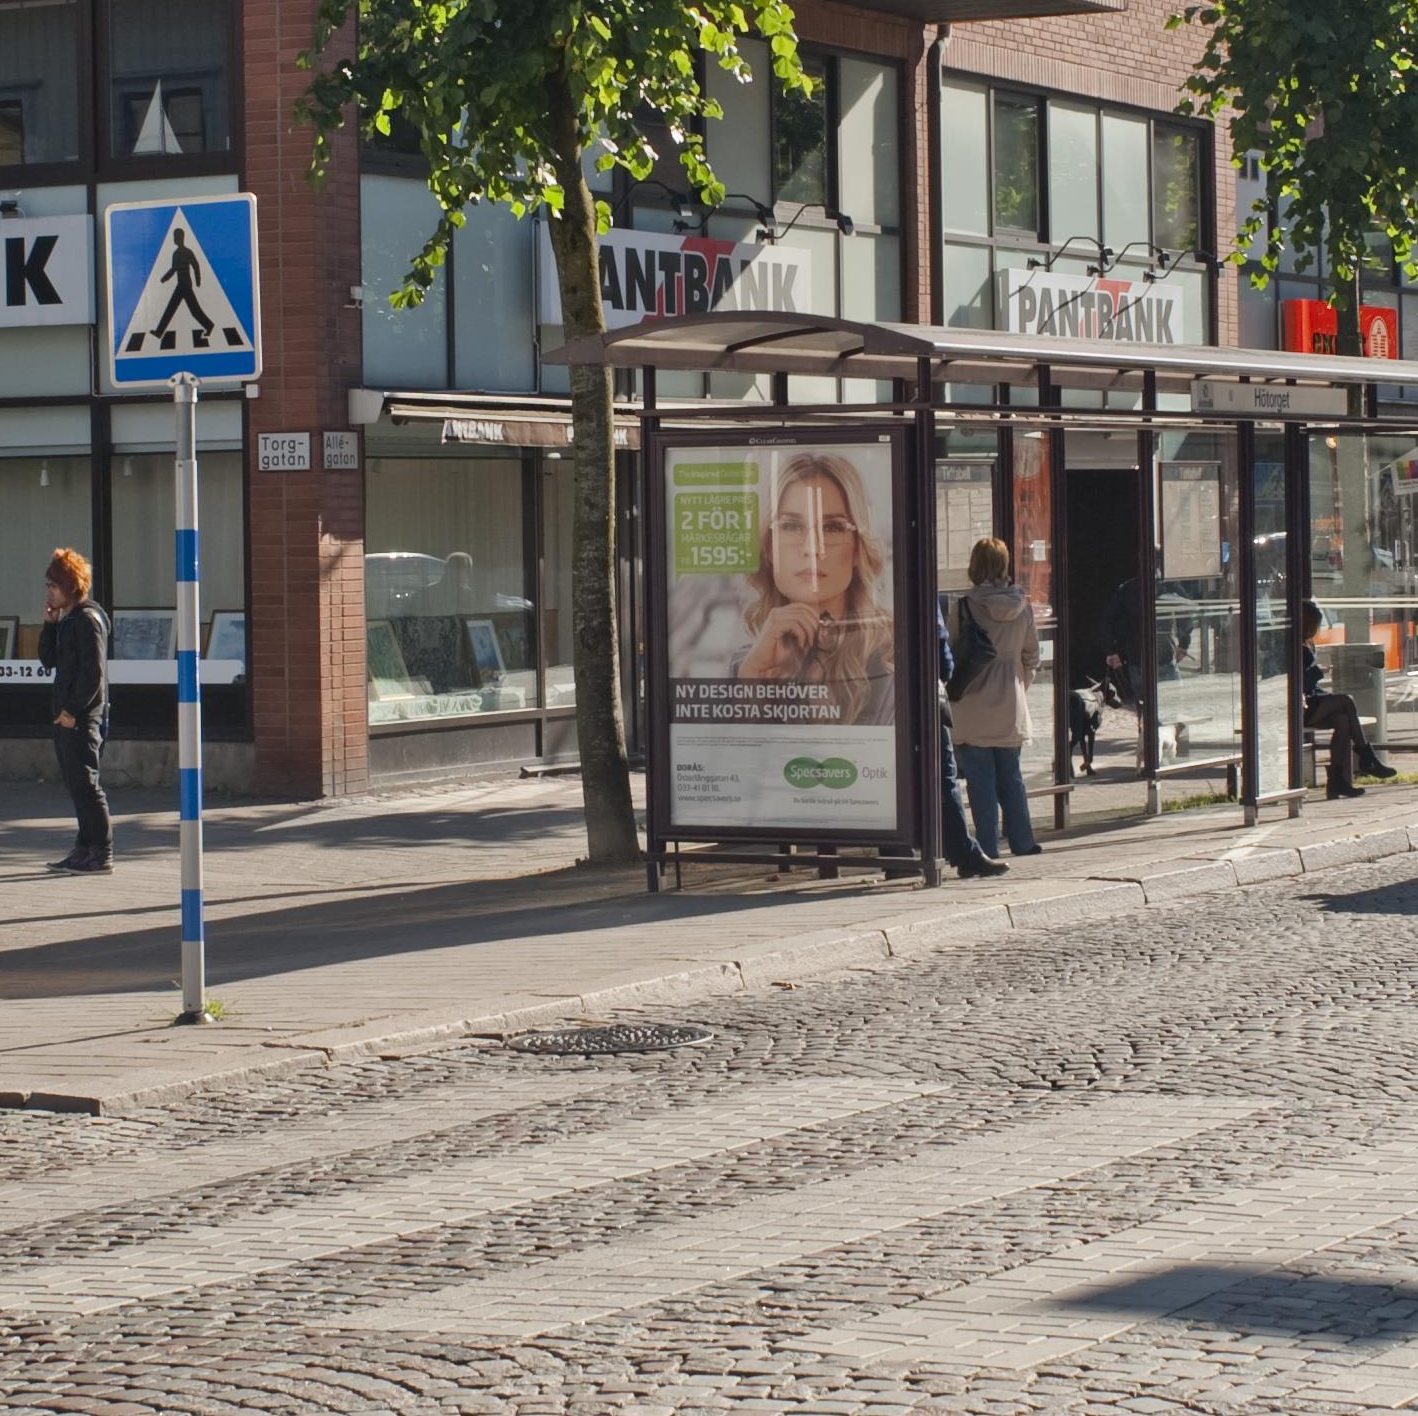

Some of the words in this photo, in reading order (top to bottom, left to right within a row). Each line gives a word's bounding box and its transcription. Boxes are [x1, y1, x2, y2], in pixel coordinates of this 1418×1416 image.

[599, 244, 798, 313] ANTBANK
[1018, 285, 1174, 344] PANTBANK
[1254, 387, 1291, 413] Hötorget
[261, 436, 305, 454] Torg-
[325, 435, 349, 450] Allé-
[262, 453, 306, 470] gatan
[326, 452, 356, 468] gatan
[681, 512, 693, 530] 2
[698, 507, 739, 530] FÖR
[744, 511, 752, 529] 1
[691, 546, 752, 566] 1595:-
[675, 684, 696, 699] NY
[699, 684, 754, 699] DESIGN
[757, 682, 828, 699] BEHÖVER
[675, 704, 710, 718] INTE
[712, 704, 760, 719] KOSTA
[764, 705, 841, 722] SKJORTAN
[790, 765, 851, 780] Specsavers
[862, 766, 888, 780] Optik
